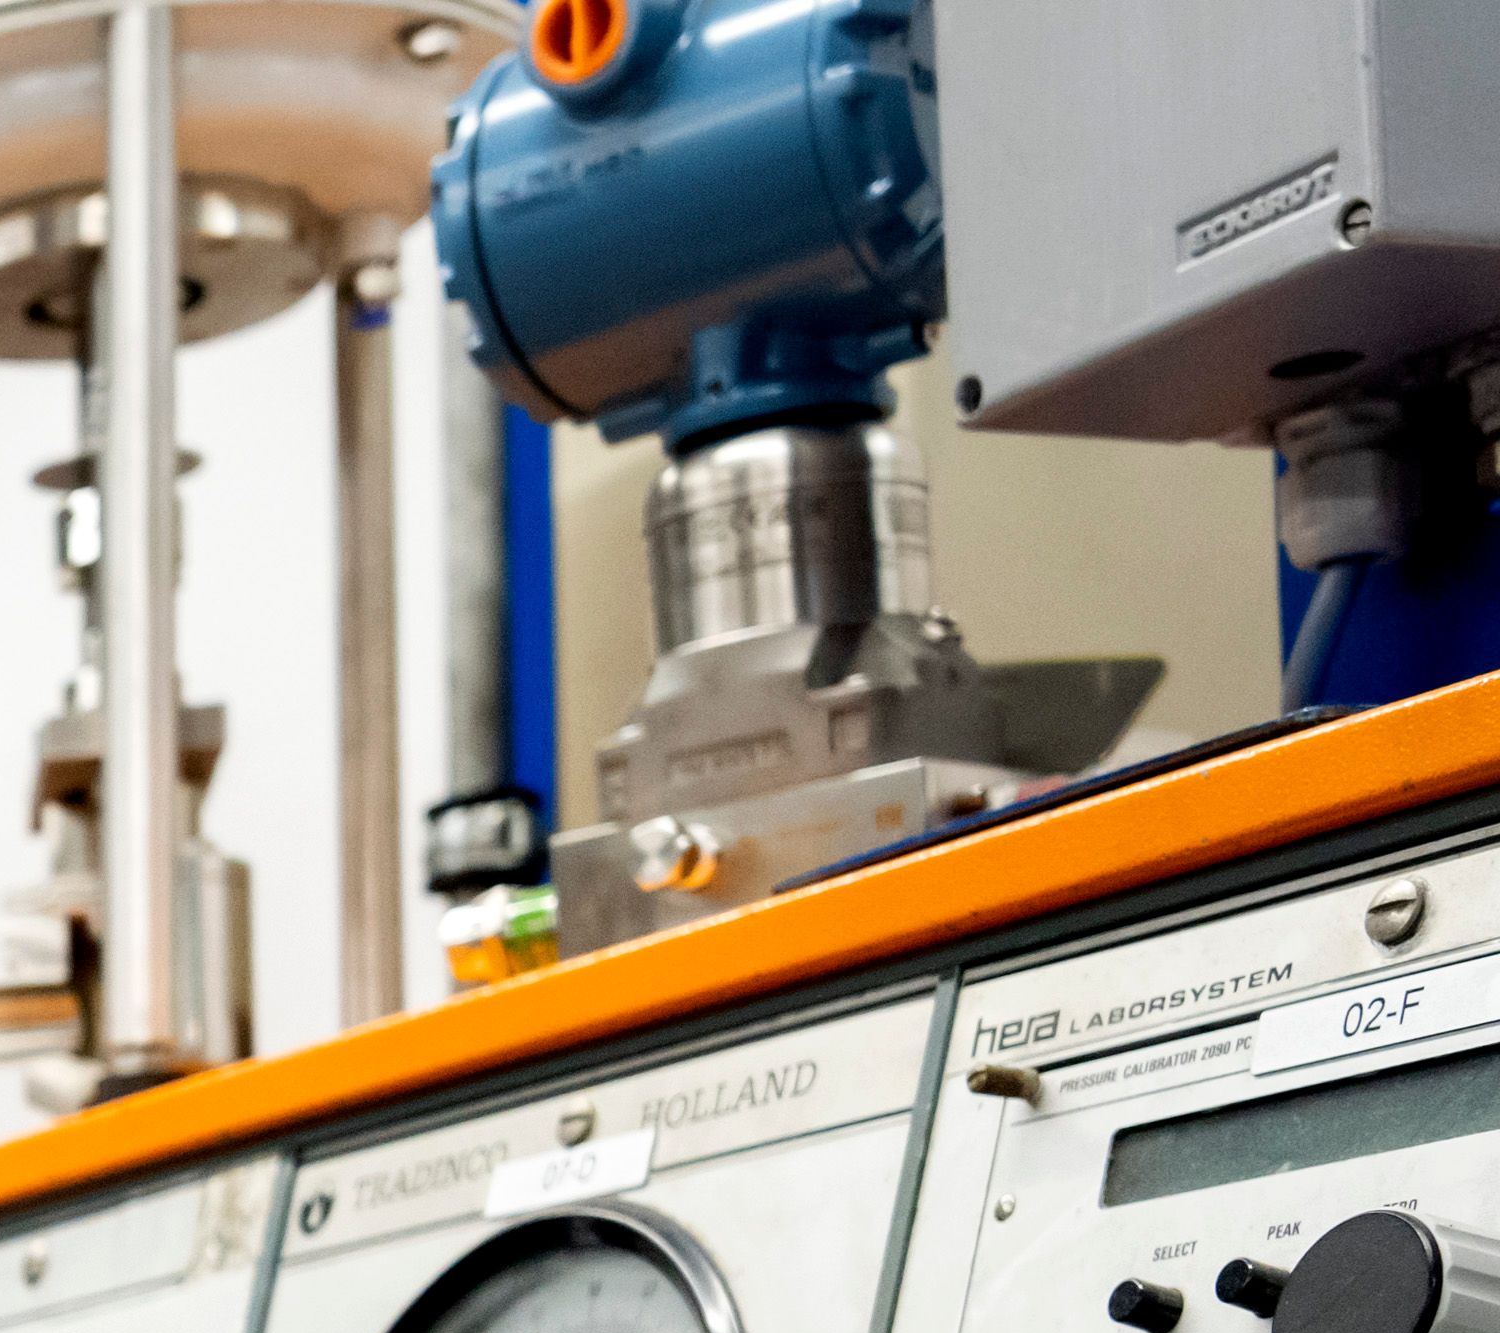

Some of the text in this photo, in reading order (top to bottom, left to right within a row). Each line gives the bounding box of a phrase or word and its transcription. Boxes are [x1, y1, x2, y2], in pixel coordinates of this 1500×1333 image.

[971, 962, 1294, 1058] hera LABORSYSTEM
[1342, 986, 1426, 1038] 02-F
[1059, 1035, 1253, 1093] PRESSURE CALIBRATOR 2090 PC
[639, 1059, 818, 1129] HOLLAND
[1151, 1240, 1198, 1262] SELECT
[1266, 1221, 1302, 1241] PEAK
